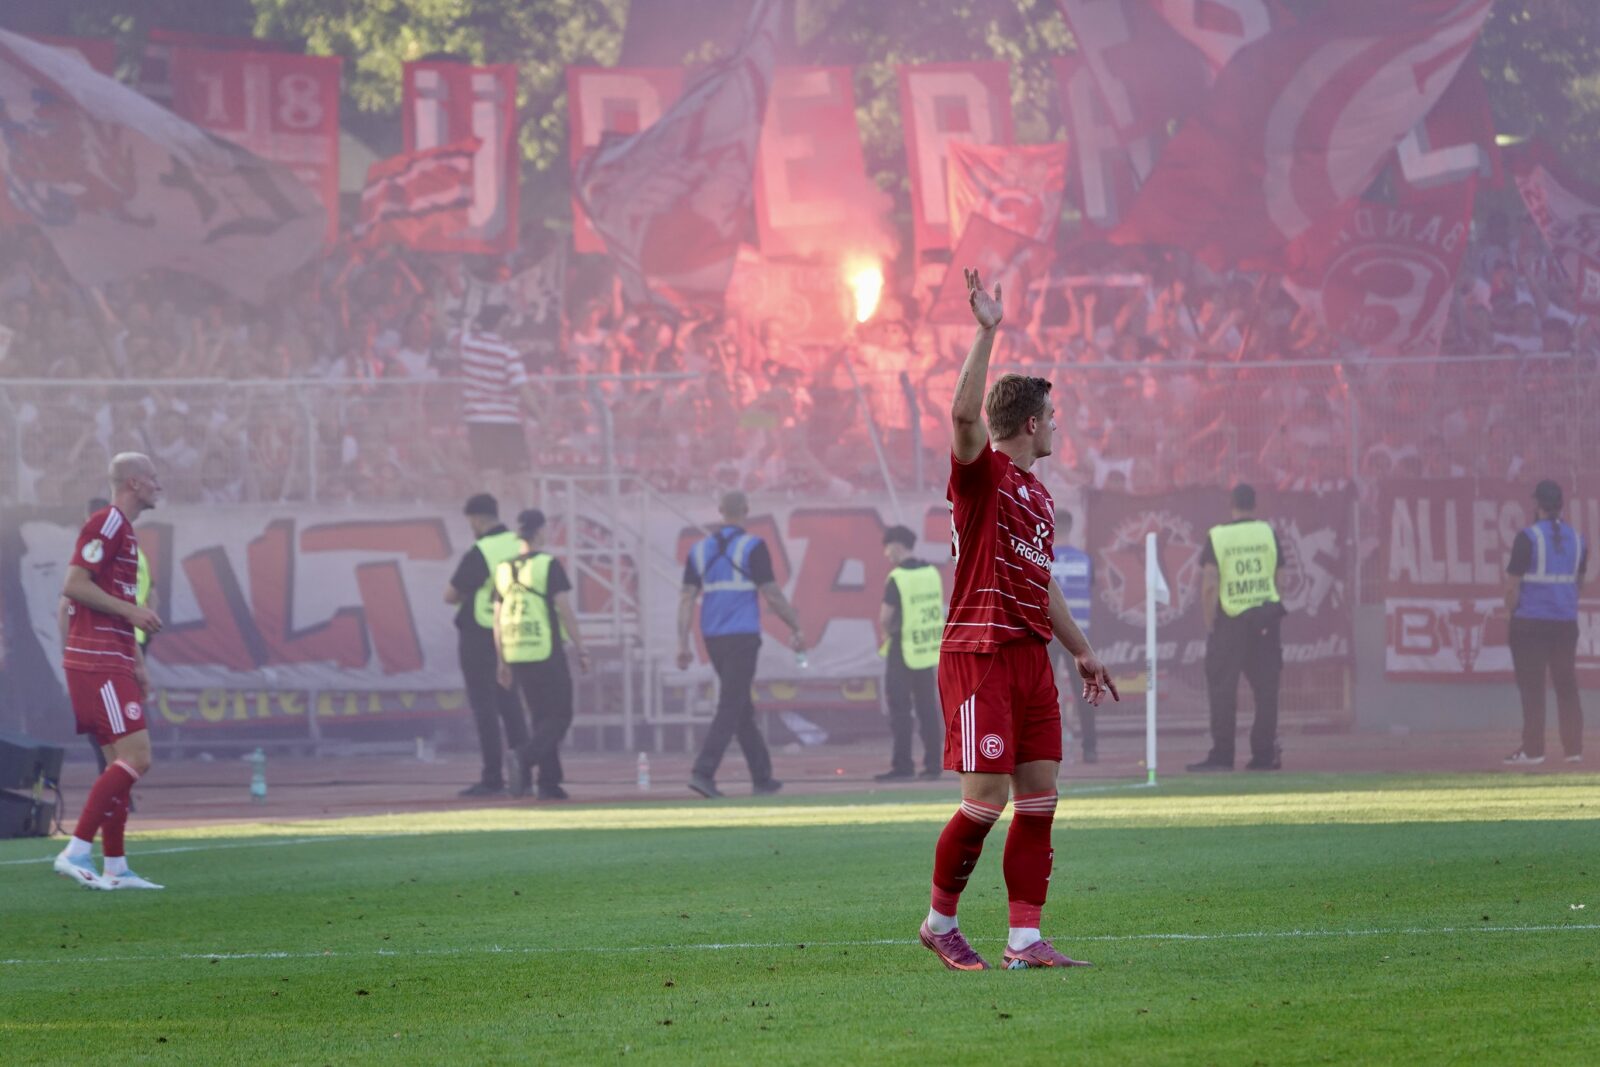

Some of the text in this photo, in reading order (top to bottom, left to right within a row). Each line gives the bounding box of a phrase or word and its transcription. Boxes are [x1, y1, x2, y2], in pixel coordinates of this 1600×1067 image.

[1011, 539, 1052, 571] RGOBA
[1388, 497, 1526, 584] ALLES
[1227, 577, 1271, 597] EMPIRE
